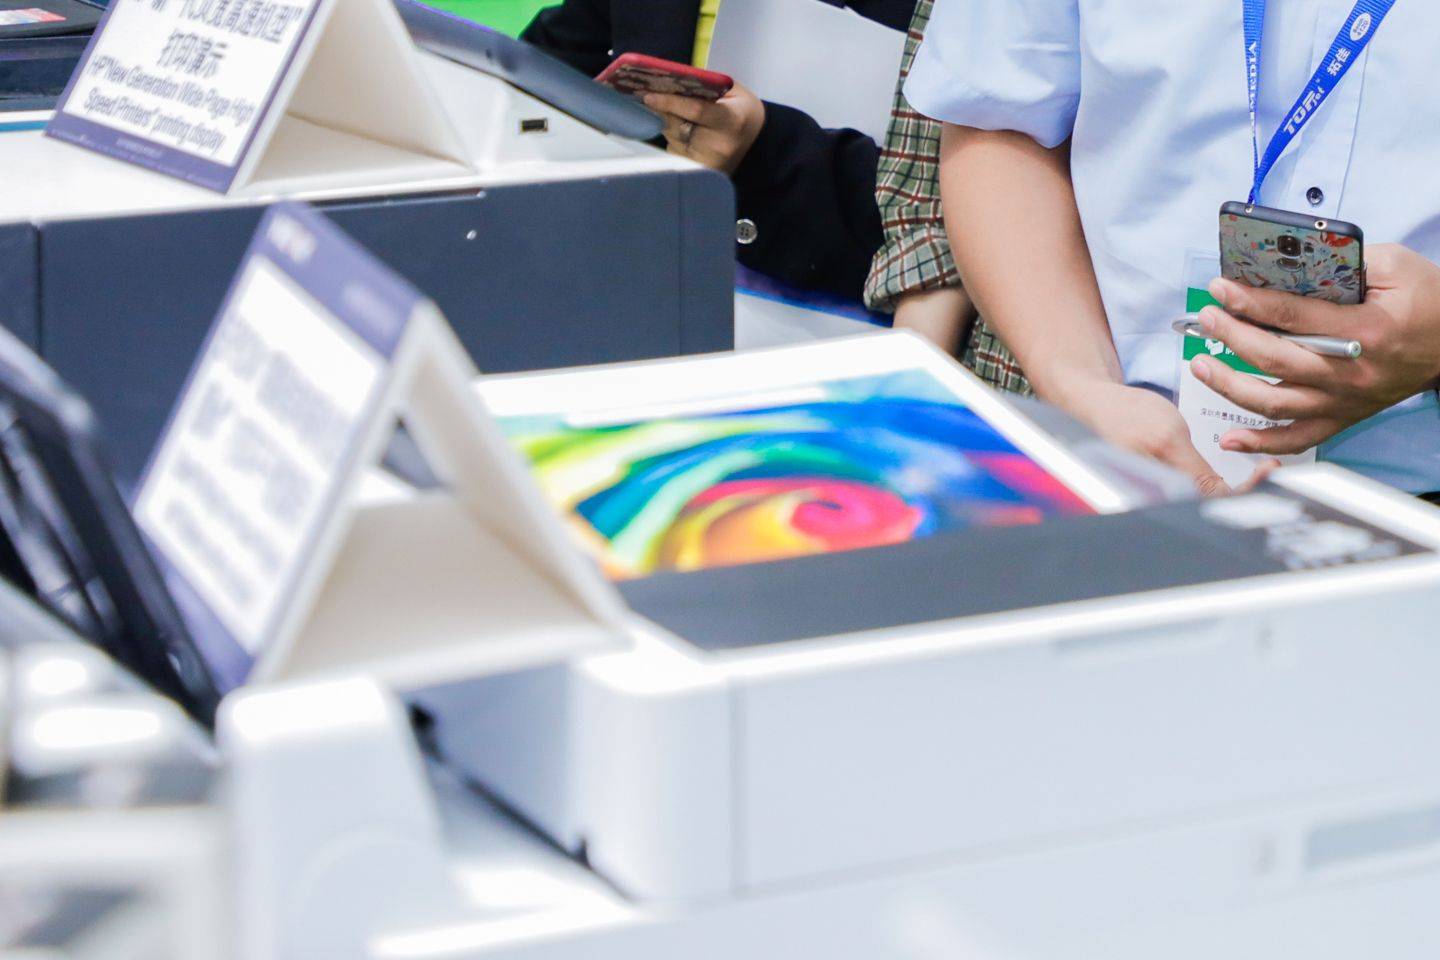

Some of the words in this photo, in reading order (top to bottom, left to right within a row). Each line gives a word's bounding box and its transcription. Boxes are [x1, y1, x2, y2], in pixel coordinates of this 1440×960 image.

[1327, 48, 1351, 76] 拓佳
[84, 87, 118, 116] Speed
[151, 114, 191, 145] printing
[188, 124, 226, 155] display
[126, 65, 179, 99] Generation
[176, 81, 204, 107] Wide
[203, 89, 232, 120] Page
[229, 98, 255, 127] High
